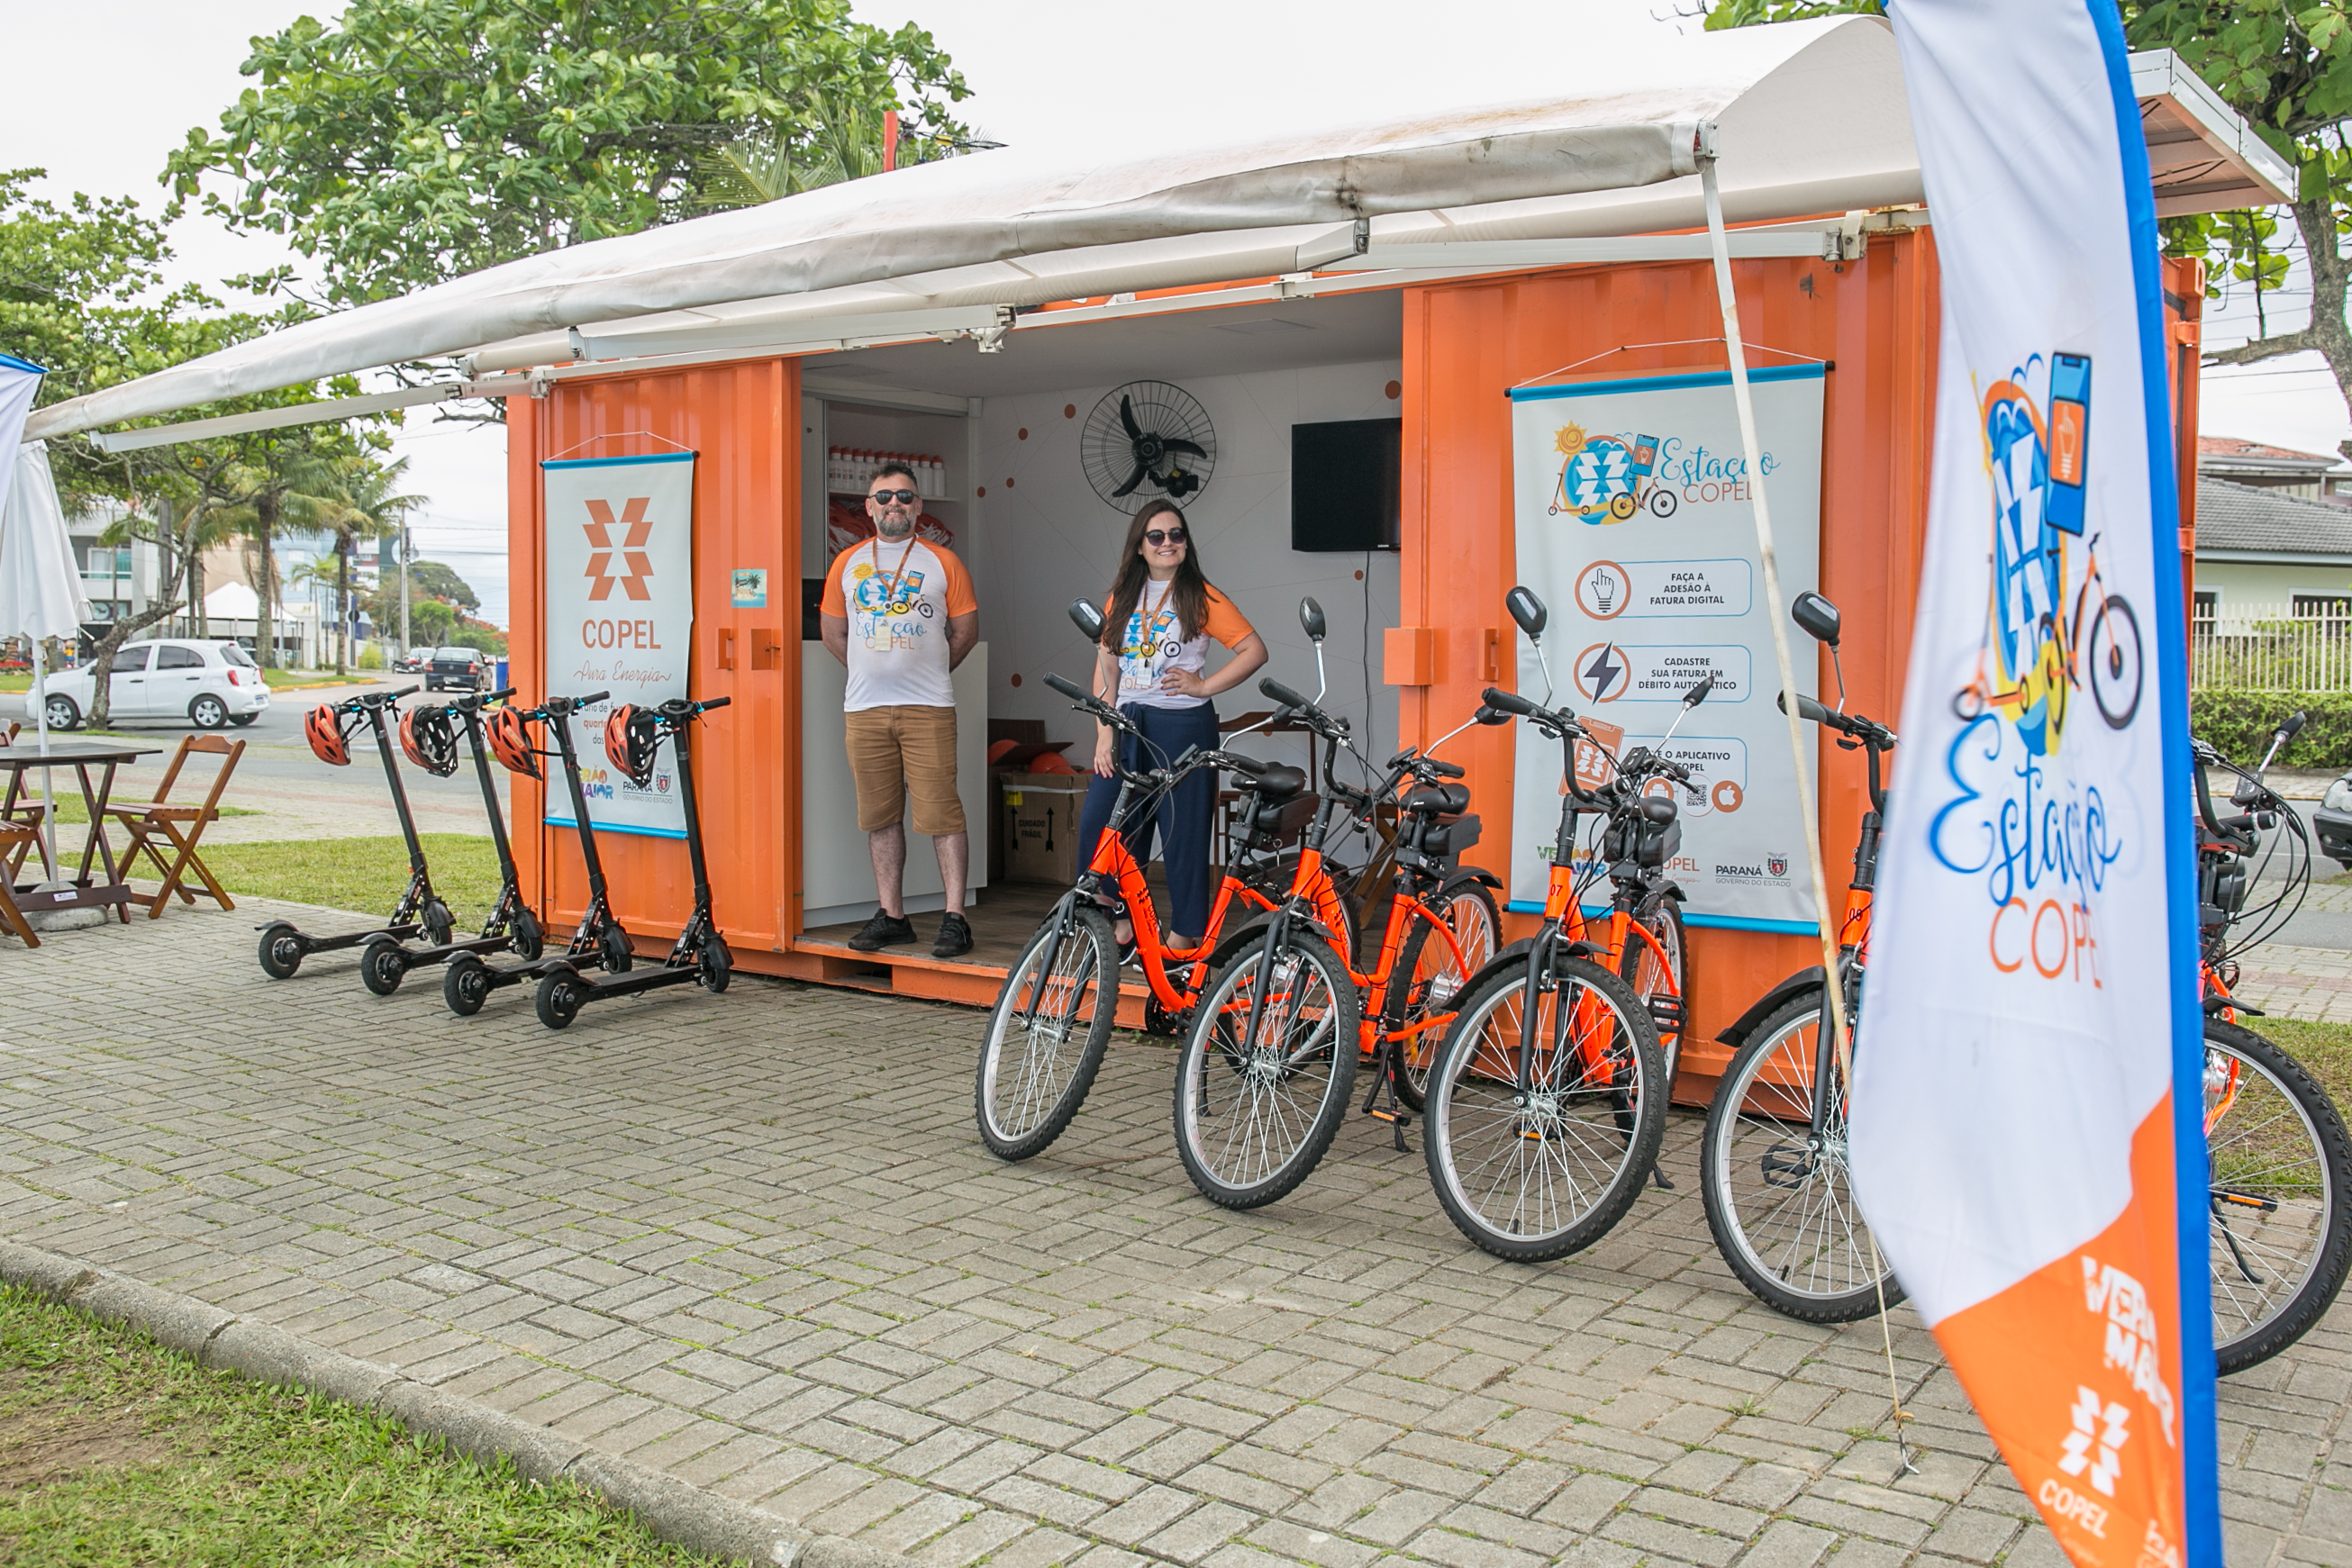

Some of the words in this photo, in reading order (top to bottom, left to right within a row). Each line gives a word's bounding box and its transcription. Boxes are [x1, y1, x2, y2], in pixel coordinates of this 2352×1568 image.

[1671, 573, 1694, 583] FAÇA
[1697, 573, 1704, 581] A
[1664, 583, 1702, 593] ADESÃO
[1704, 582, 1711, 592] À
[1650, 596, 1685, 604] FATURA
[1688, 596, 1724, 604] DIGITAL
[856, 611, 928, 639] Estção
[582, 619, 661, 649] COPEL
[865, 636, 915, 650] CPEL
[1665, 657, 1711, 666] CADASTRE
[612, 660, 672, 689] Energia
[1651, 669, 1669, 677] SUA
[1672, 669, 1707, 677] FATURA
[1710, 669, 1723, 678] EM
[1639, 679, 1671, 689] DÉBITO
[599, 702, 608, 713] de
[593, 733, 604, 745] das
[1665, 750, 1674, 759] O
[1675, 751, 1730, 761] APLICATIVO
[623, 793, 645, 802] GOVERNO
[653, 797, 674, 805] ESTADO
[1018, 820, 1046, 828] CUIDADO
[1021, 829, 1042, 838] FRÁGIL
[1715, 865, 1763, 876] PARANÁ
[1715, 877, 1750, 885] GOVERNO
[1763, 880, 1791, 888] ESTADO
[1550, 884, 1564, 897] 07
[2039, 1478, 2110, 1541] COPEL
